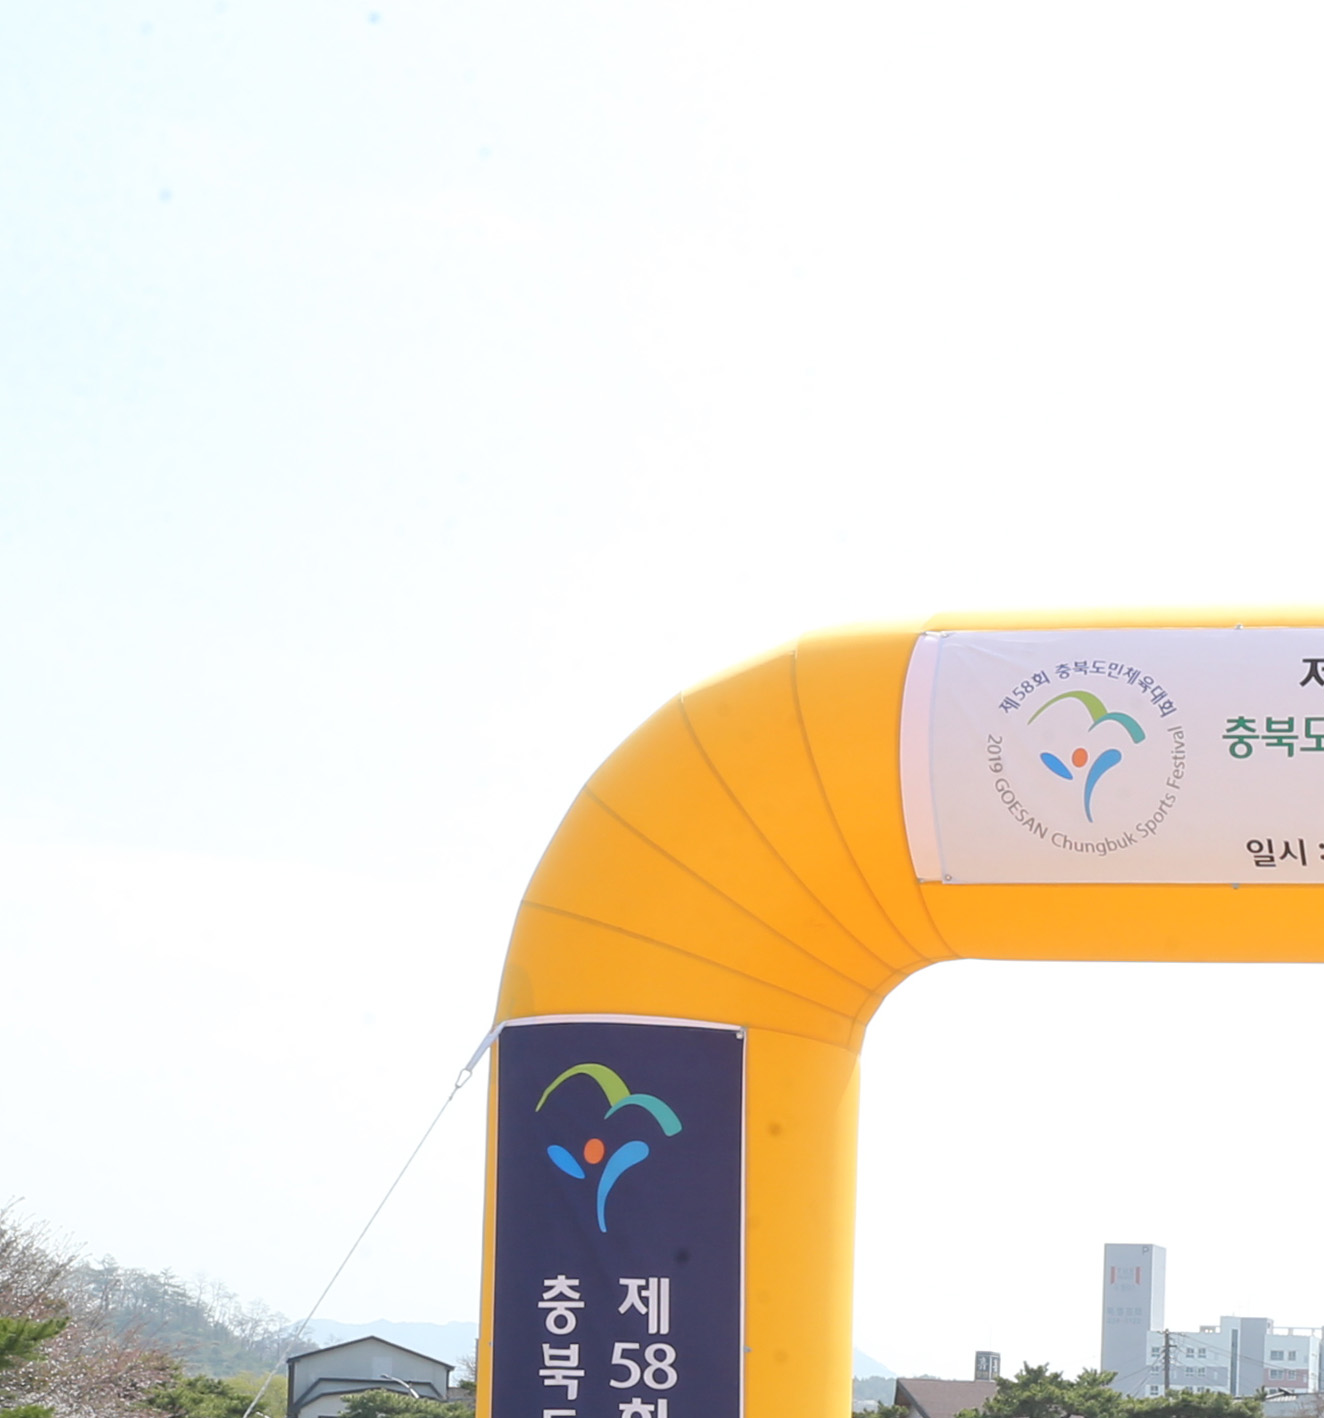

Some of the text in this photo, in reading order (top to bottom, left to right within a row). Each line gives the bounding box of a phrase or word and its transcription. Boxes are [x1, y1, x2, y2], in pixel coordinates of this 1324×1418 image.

[998, 659, 1178, 719] 제58회 충북도민체육대회
[986, 725, 1187, 857] 2019 GOESAN Chungbuk Sports Festival
[1245, 838, 1308, 868] 일시
